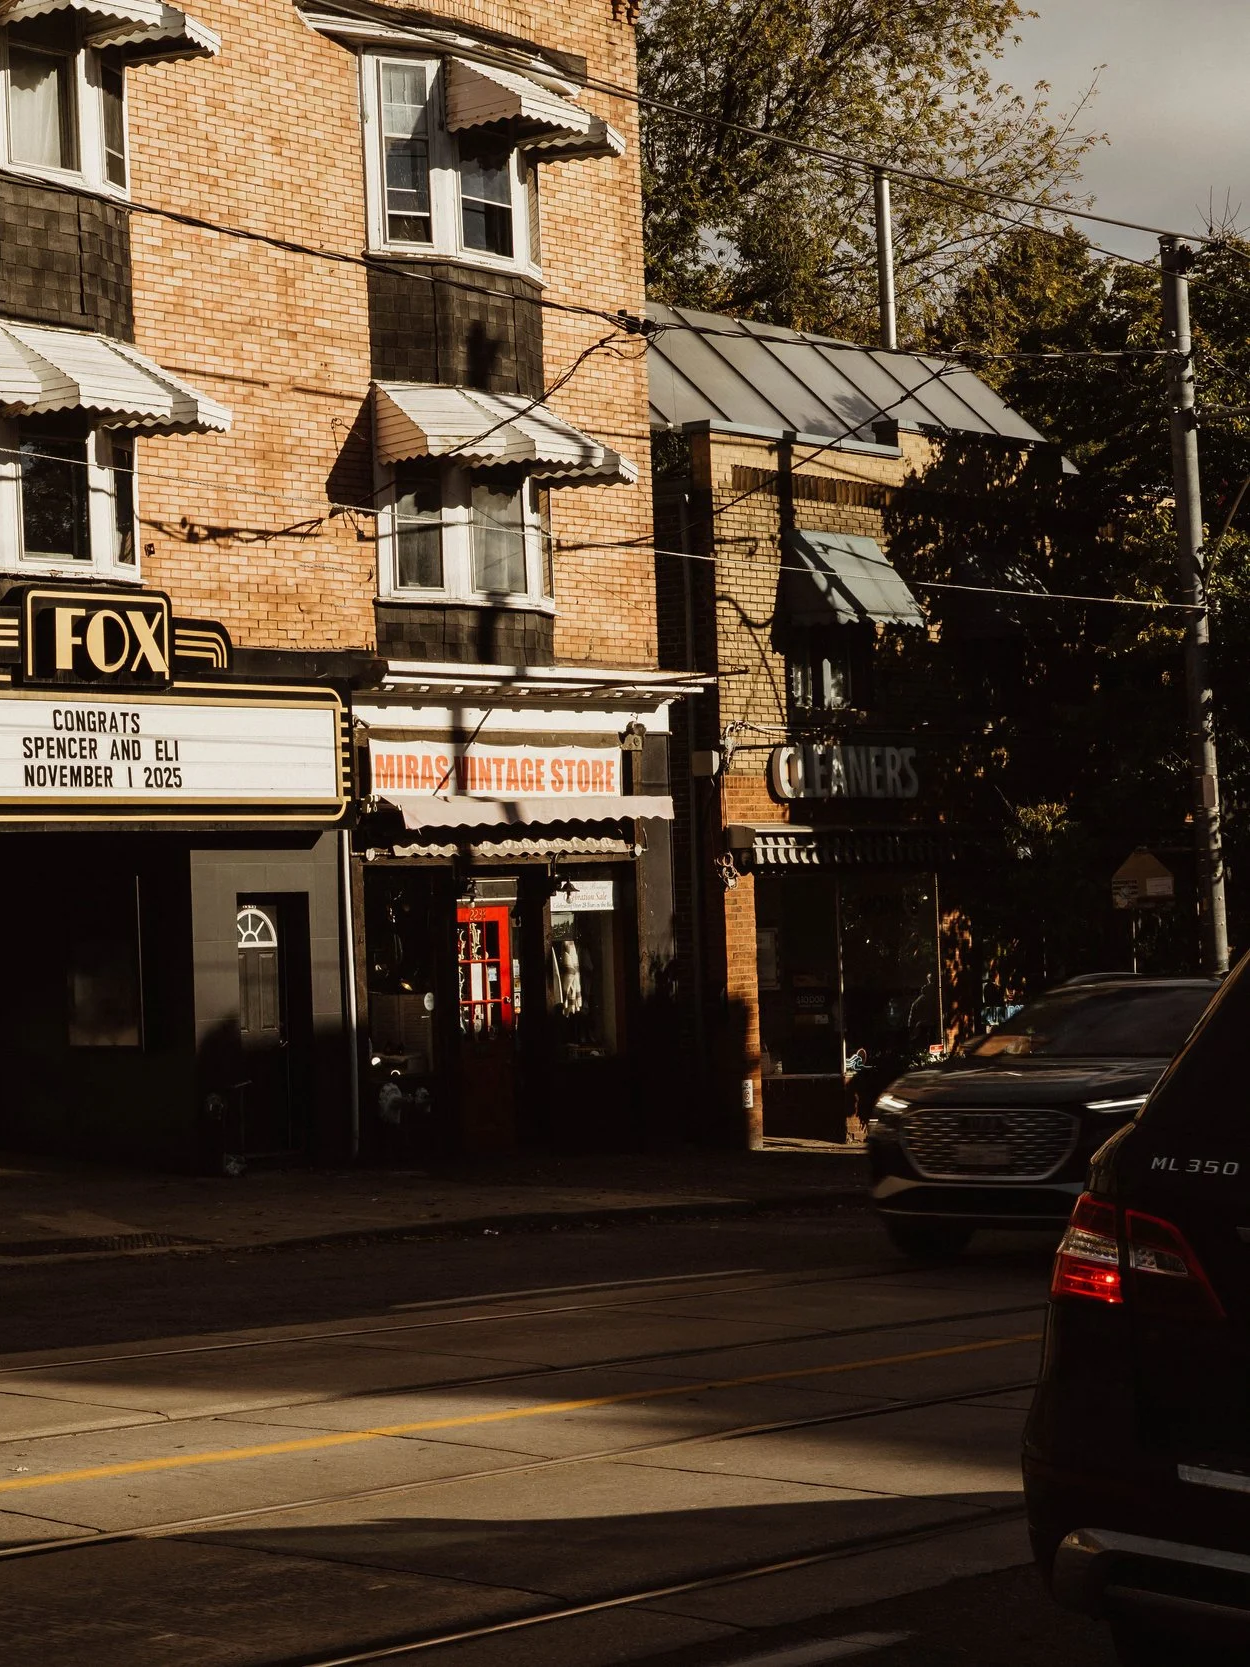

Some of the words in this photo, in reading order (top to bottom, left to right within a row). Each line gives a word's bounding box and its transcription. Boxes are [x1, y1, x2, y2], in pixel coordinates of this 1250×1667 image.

[55, 607, 169, 674] FOX
[53, 709, 141, 734] CONGRATS
[22, 737, 98, 760] SPENCER
[110, 739, 142, 761] AND
[155, 740, 179, 761] ELI
[24, 765, 113, 788] NOVEMBER
[144, 767, 183, 788] 2025
[374, 754, 449, 790] MIRAS
[454, 755, 546, 793] VINTAGE
[551, 758, 615, 793] STORE
[773, 745, 919, 799] CLEANERS
[1150, 1157, 1178, 1171] ML
[1185, 1159, 1240, 1175] 350
